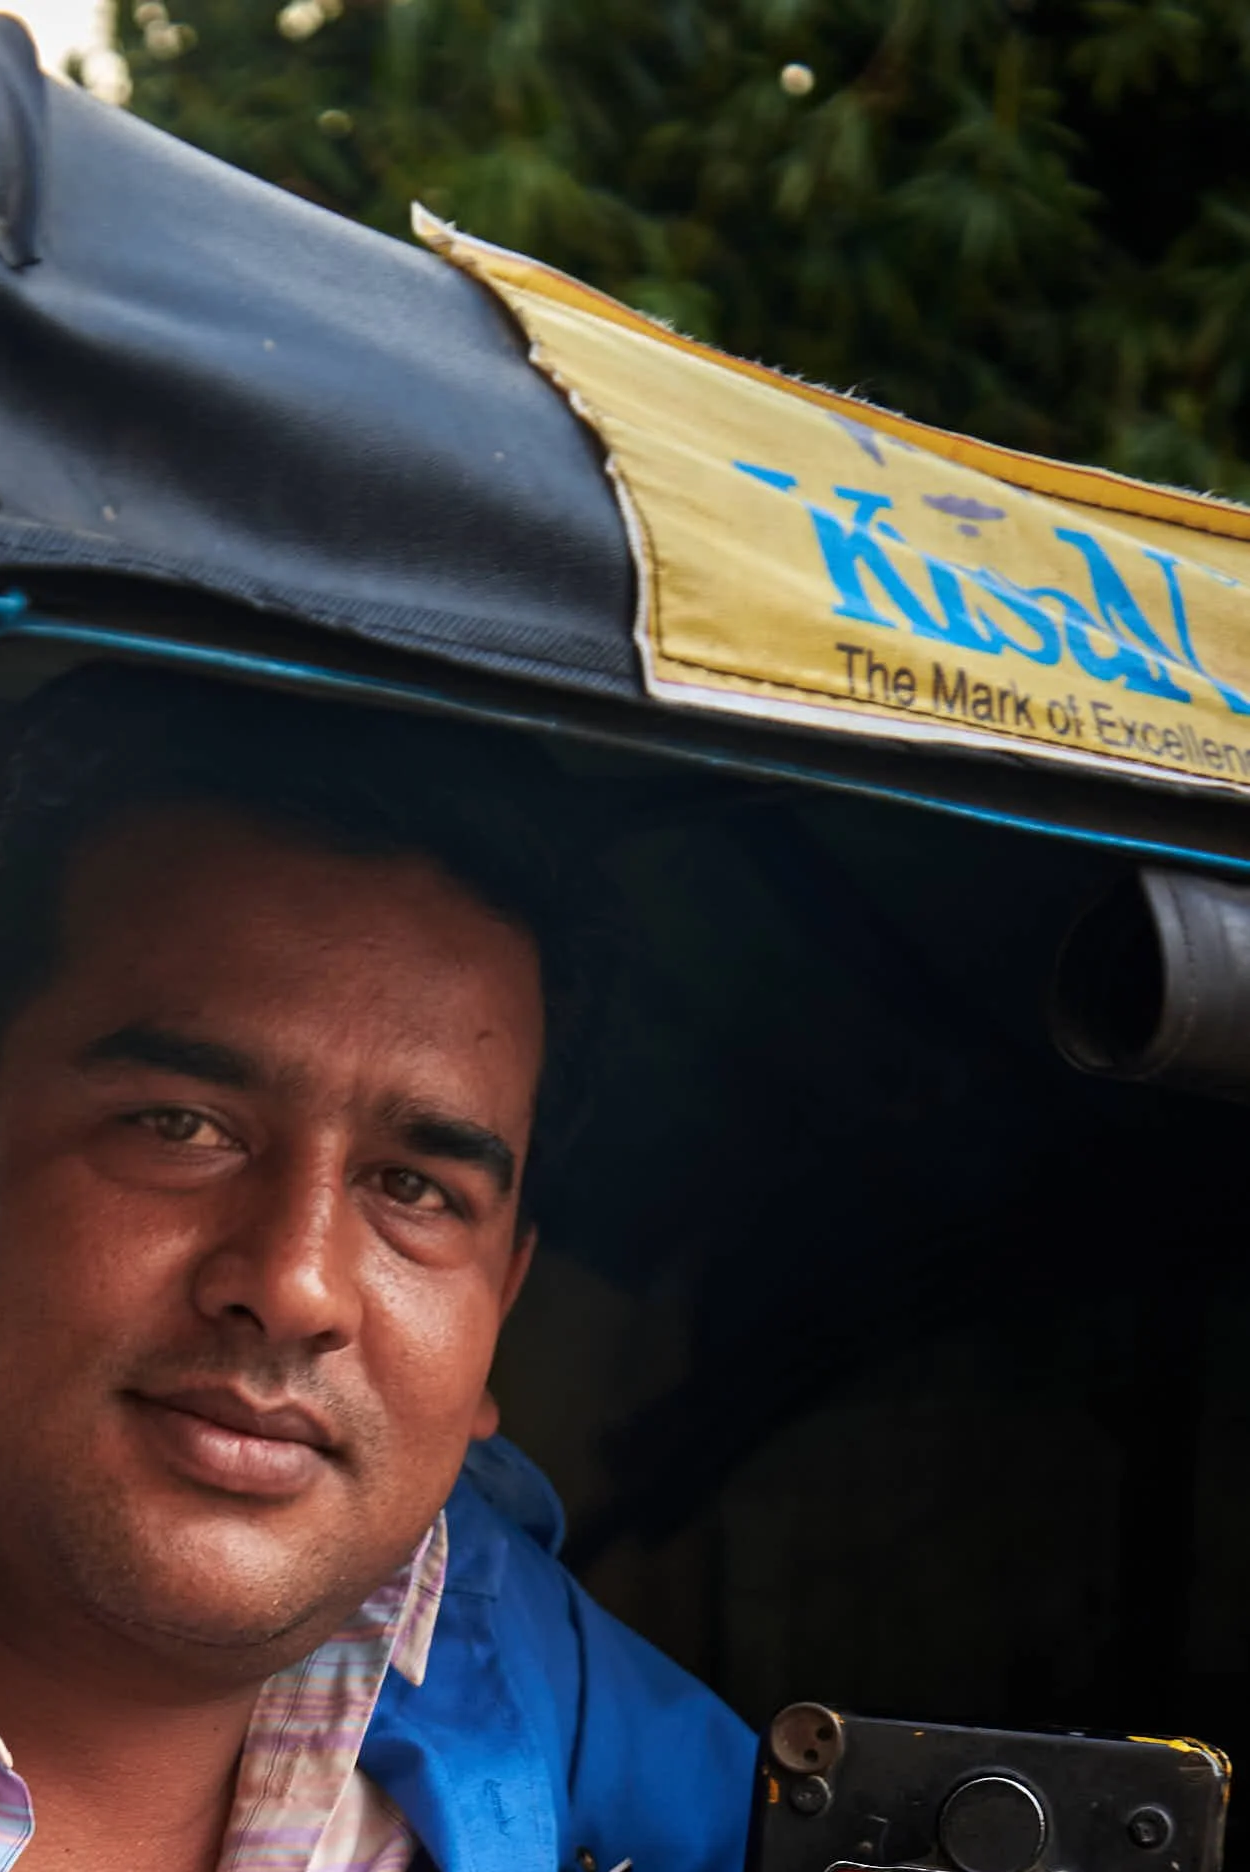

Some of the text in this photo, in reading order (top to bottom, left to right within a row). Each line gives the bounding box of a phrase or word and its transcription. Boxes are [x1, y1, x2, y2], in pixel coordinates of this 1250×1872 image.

[836, 642, 1250, 775] The Mark of Excellen
